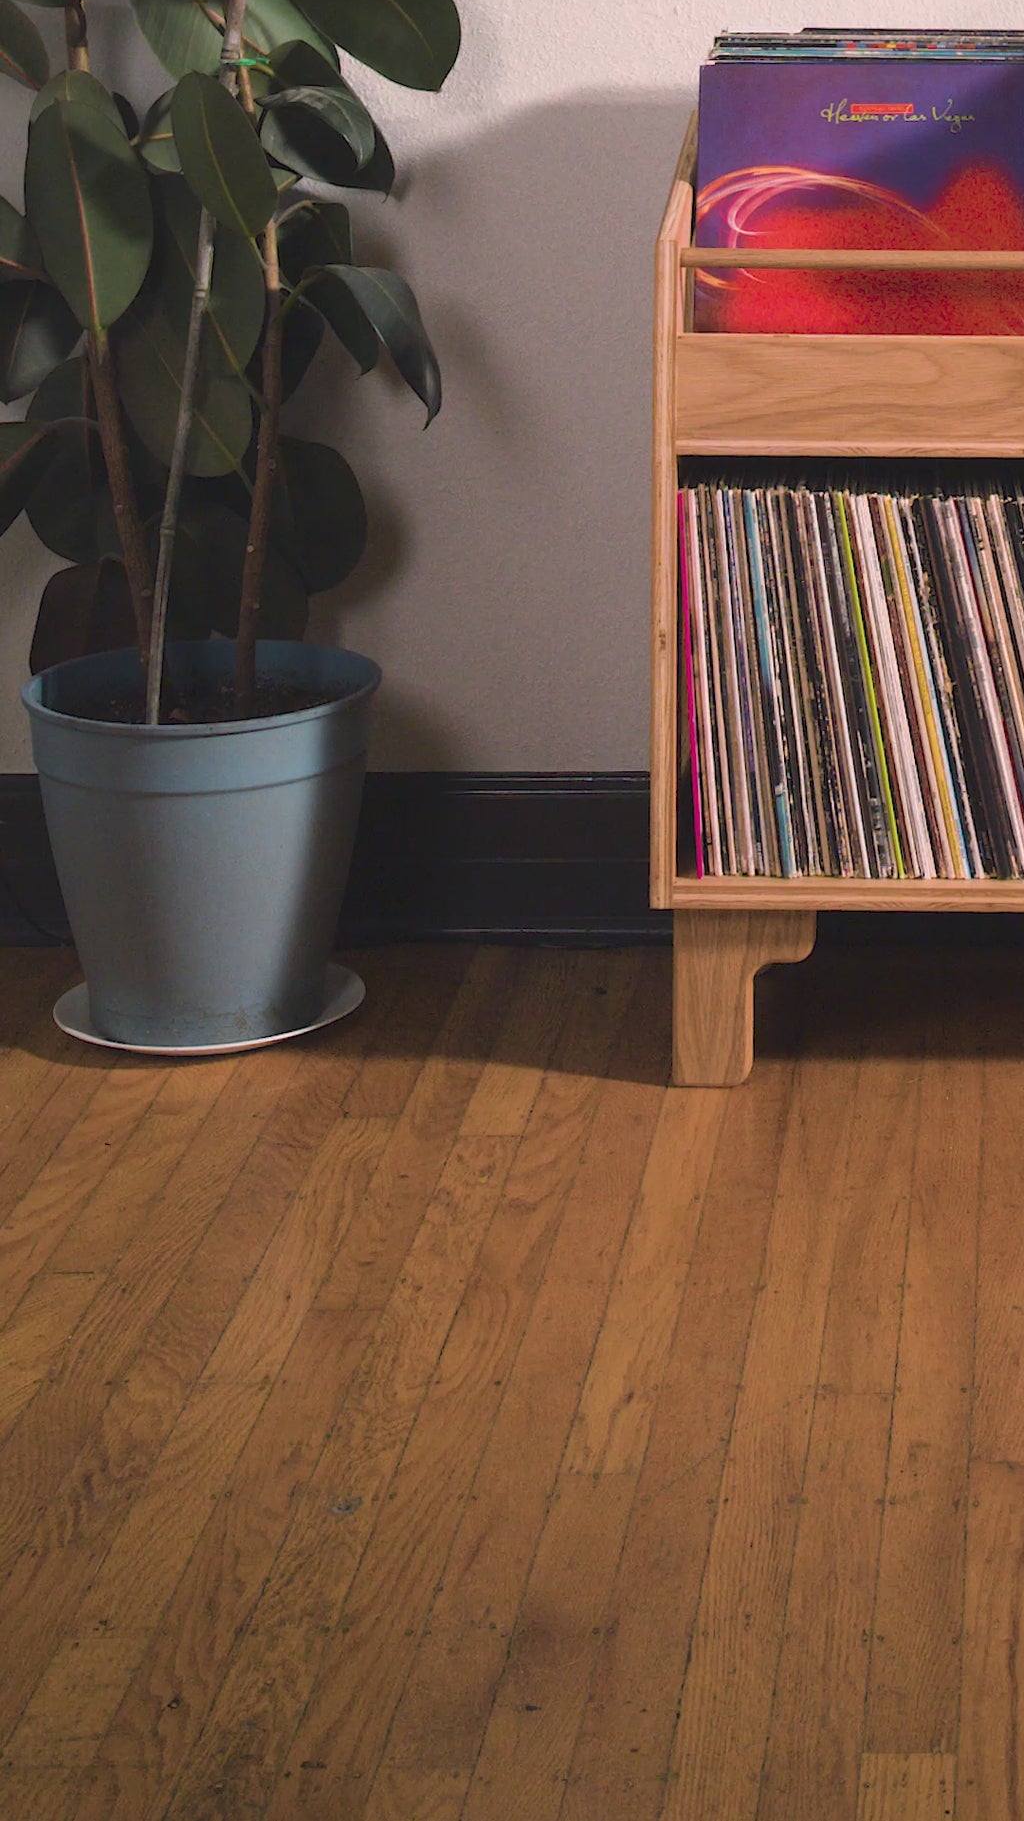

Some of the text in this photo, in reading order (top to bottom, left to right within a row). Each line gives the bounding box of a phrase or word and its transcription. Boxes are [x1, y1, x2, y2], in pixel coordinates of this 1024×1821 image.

[820, 97, 879, 124] Heaven
[882, 113, 900, 122] or
[931, 98, 976, 133] Vegas
